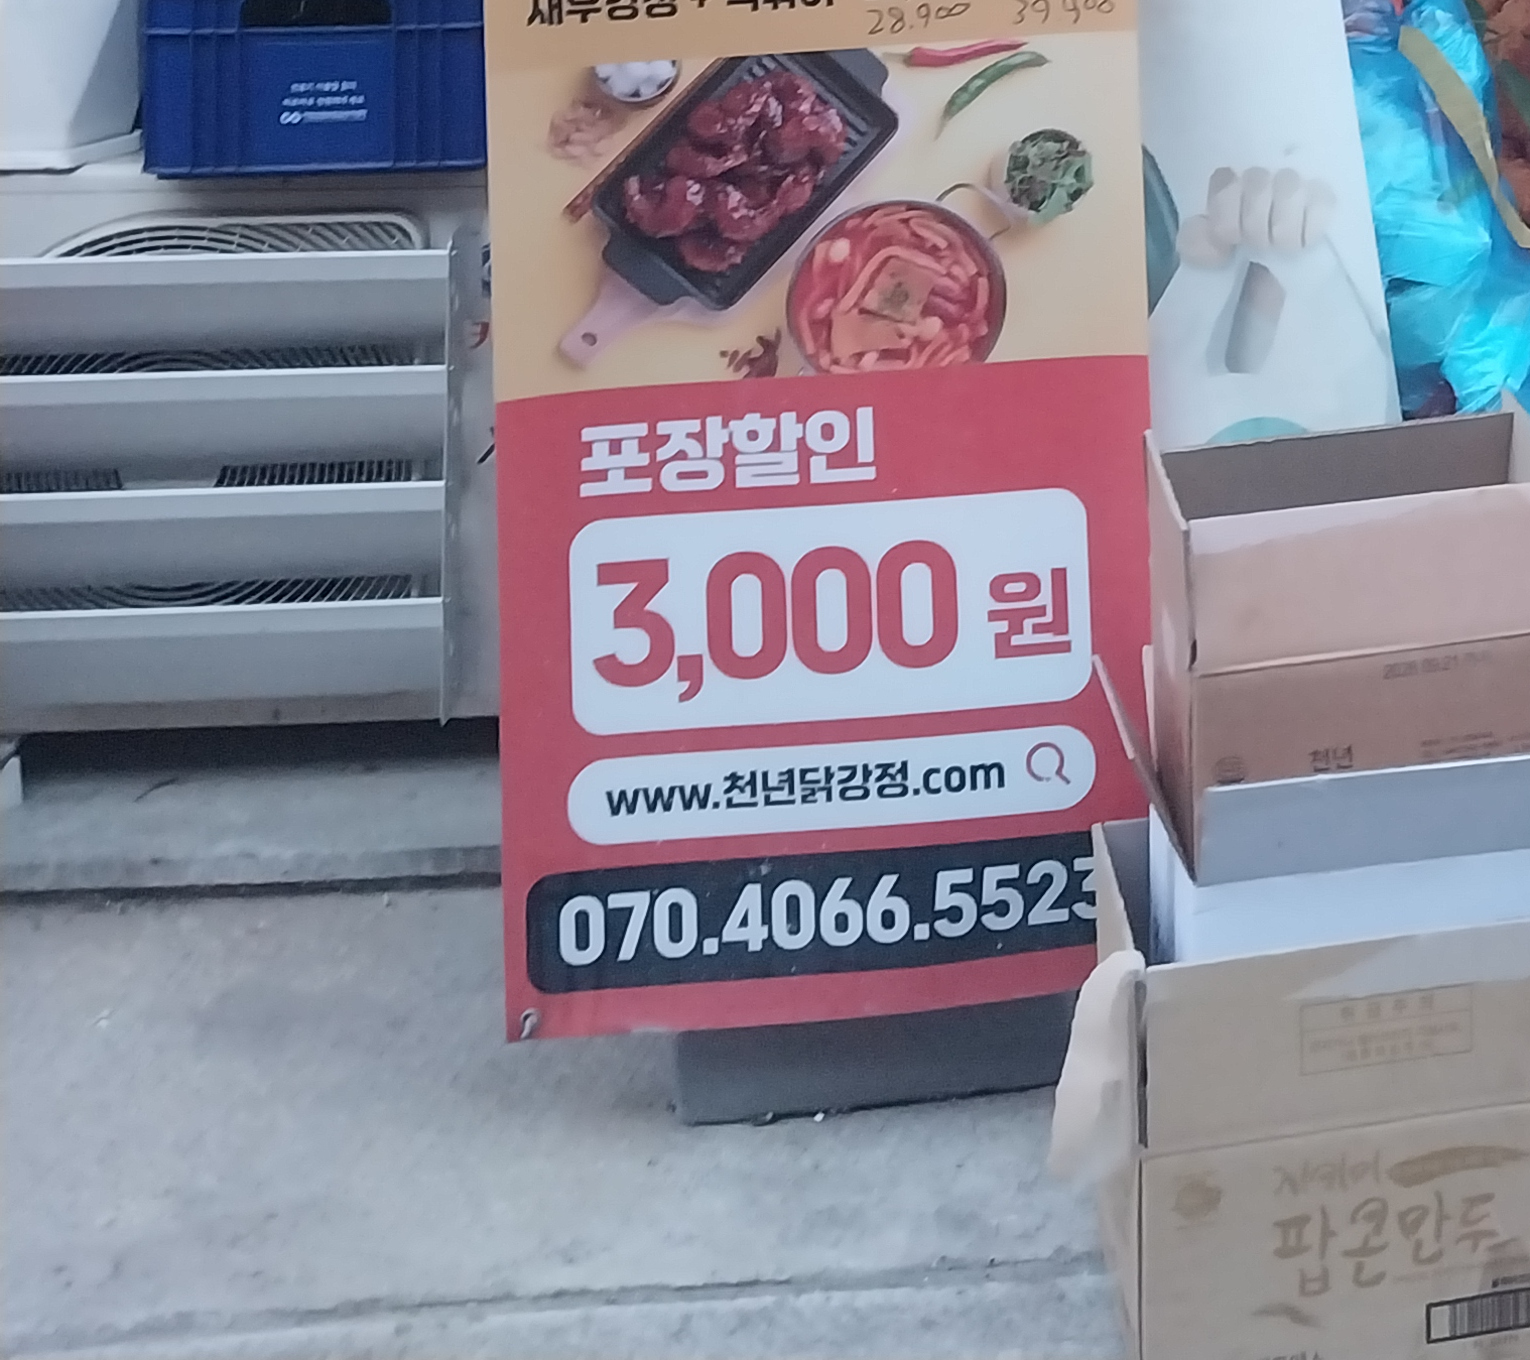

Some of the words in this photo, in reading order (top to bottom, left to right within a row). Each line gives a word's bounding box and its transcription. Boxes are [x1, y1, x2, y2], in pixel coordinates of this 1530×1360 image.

[579, 406, 877, 497] 포장할인
[592, 539, 959, 703] 3,000
[987, 566, 1072, 660] 원
[605, 757, 1006, 818] www.천년닭강정.com
[557, 856, 1098, 967] 070.4066.5523
